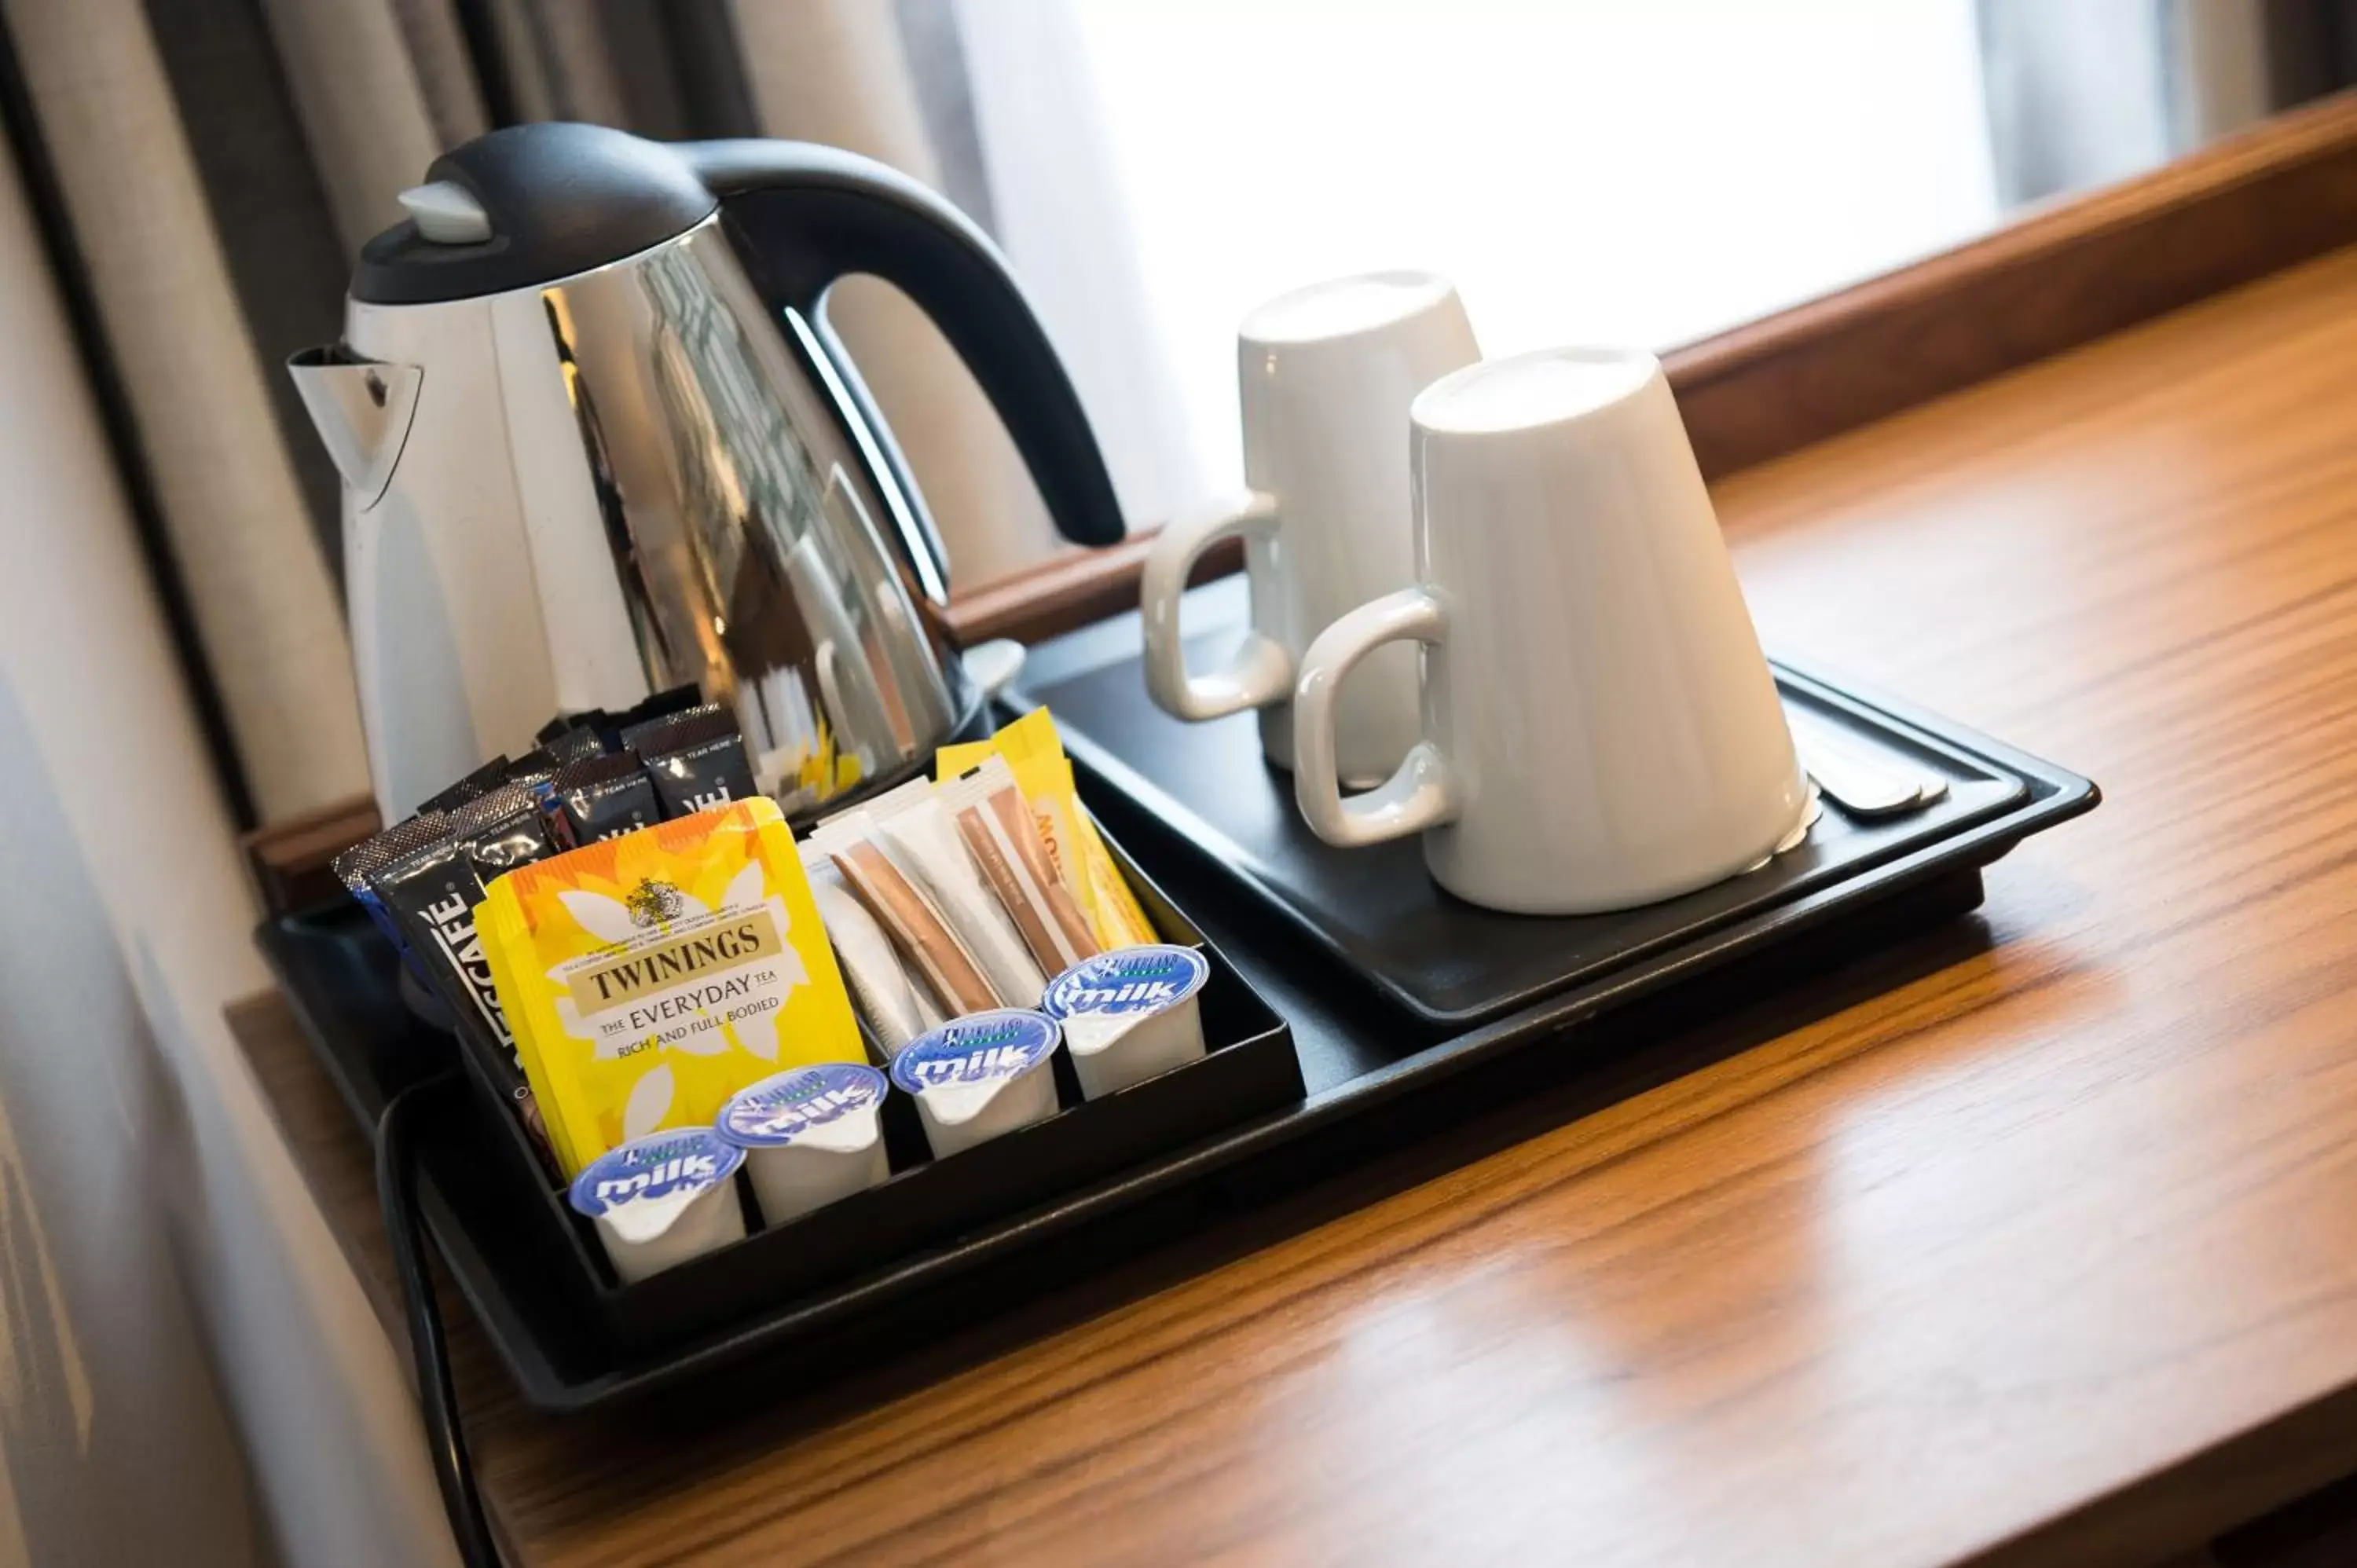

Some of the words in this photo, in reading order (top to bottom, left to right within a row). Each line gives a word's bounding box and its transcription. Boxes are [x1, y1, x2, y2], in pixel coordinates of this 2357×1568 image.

[687, 746, 709, 760] TEAR
[590, 924, 761, 1000] TWININGS
[599, 1019, 626, 1035] THE
[629, 973, 750, 1030] EVERYDAY
[753, 970, 777, 982] TEA
[1066, 981, 1178, 1003] milk
[618, 1039, 651, 1059] RICH
[656, 1027, 687, 1046] AND
[691, 1014, 724, 1035] FULL
[727, 996, 779, 1022] BODIED
[915, 1044, 1033, 1075] milk
[751, 1085, 871, 1135] milk
[596, 1154, 715, 1198] milk
